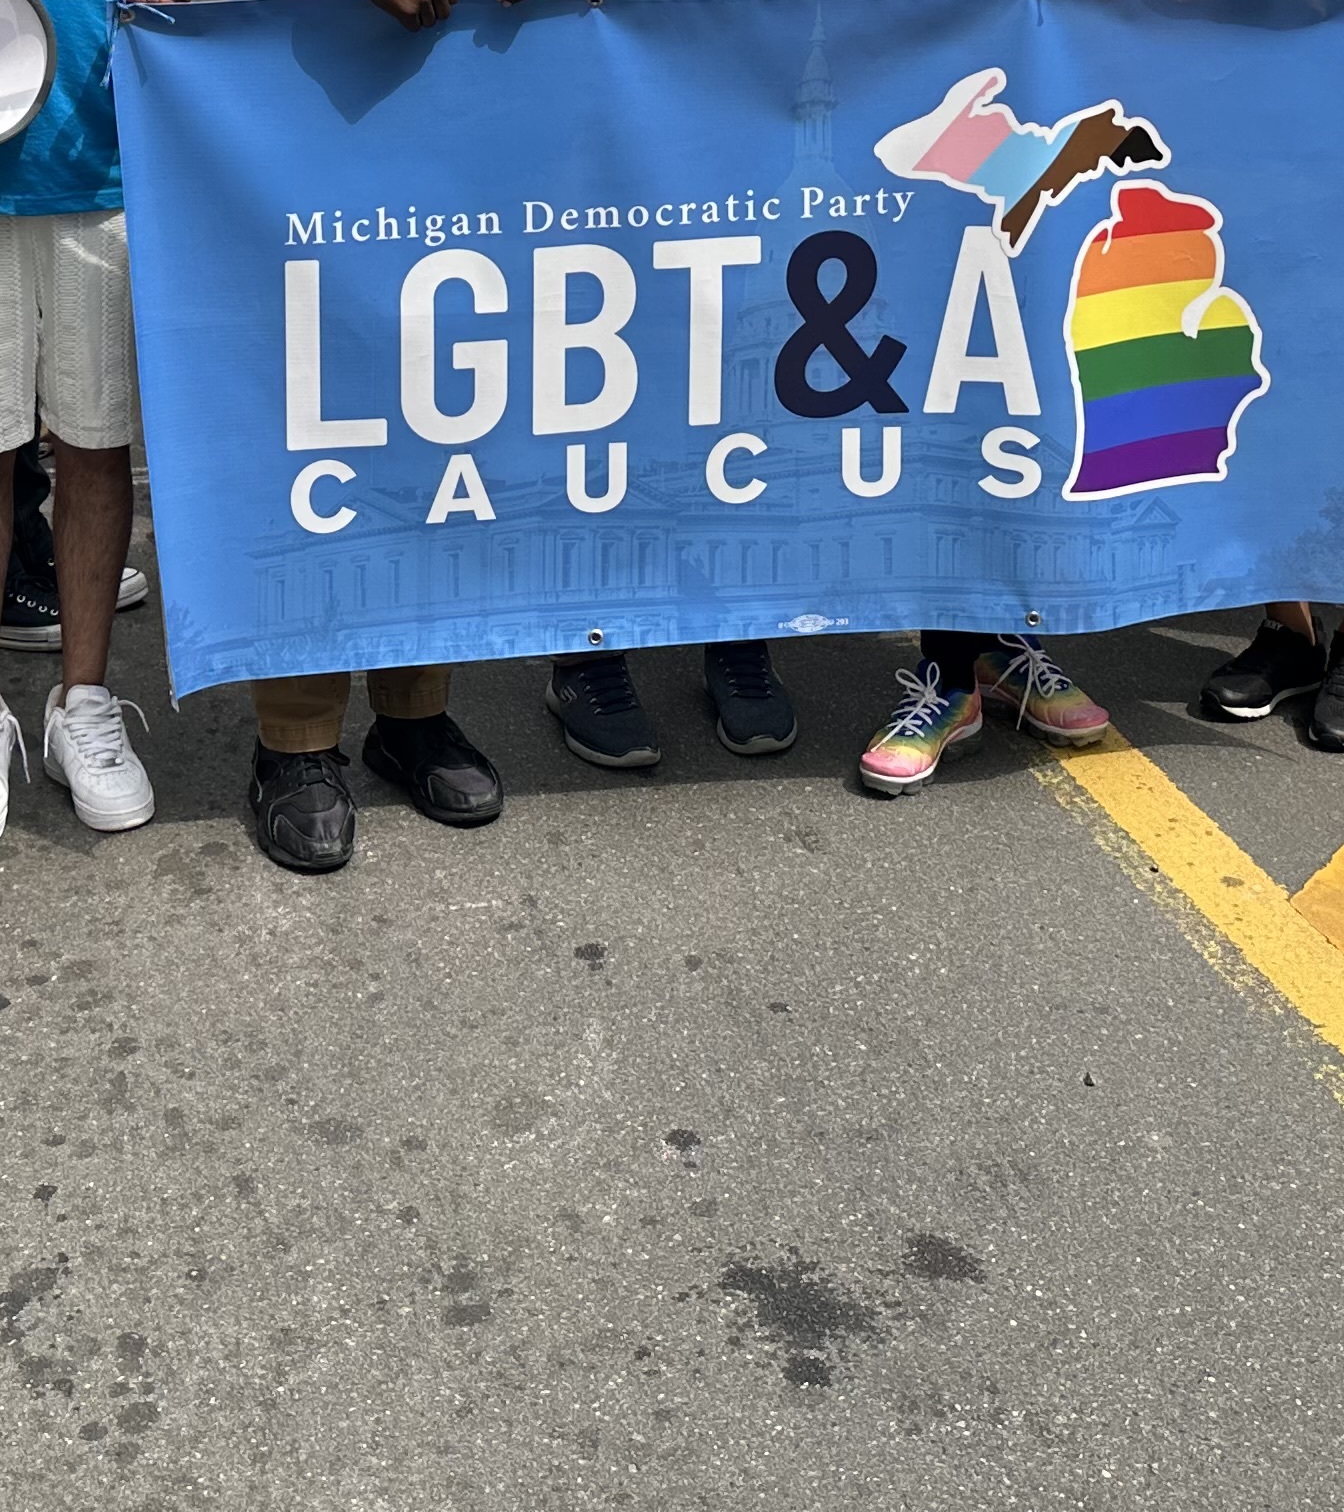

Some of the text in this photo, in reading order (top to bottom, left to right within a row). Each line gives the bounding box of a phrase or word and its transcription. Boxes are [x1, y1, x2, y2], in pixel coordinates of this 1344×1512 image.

[284, 186, 916, 247] Michigan Democratic Party
[290, 426, 1043, 535] CAUCUS
